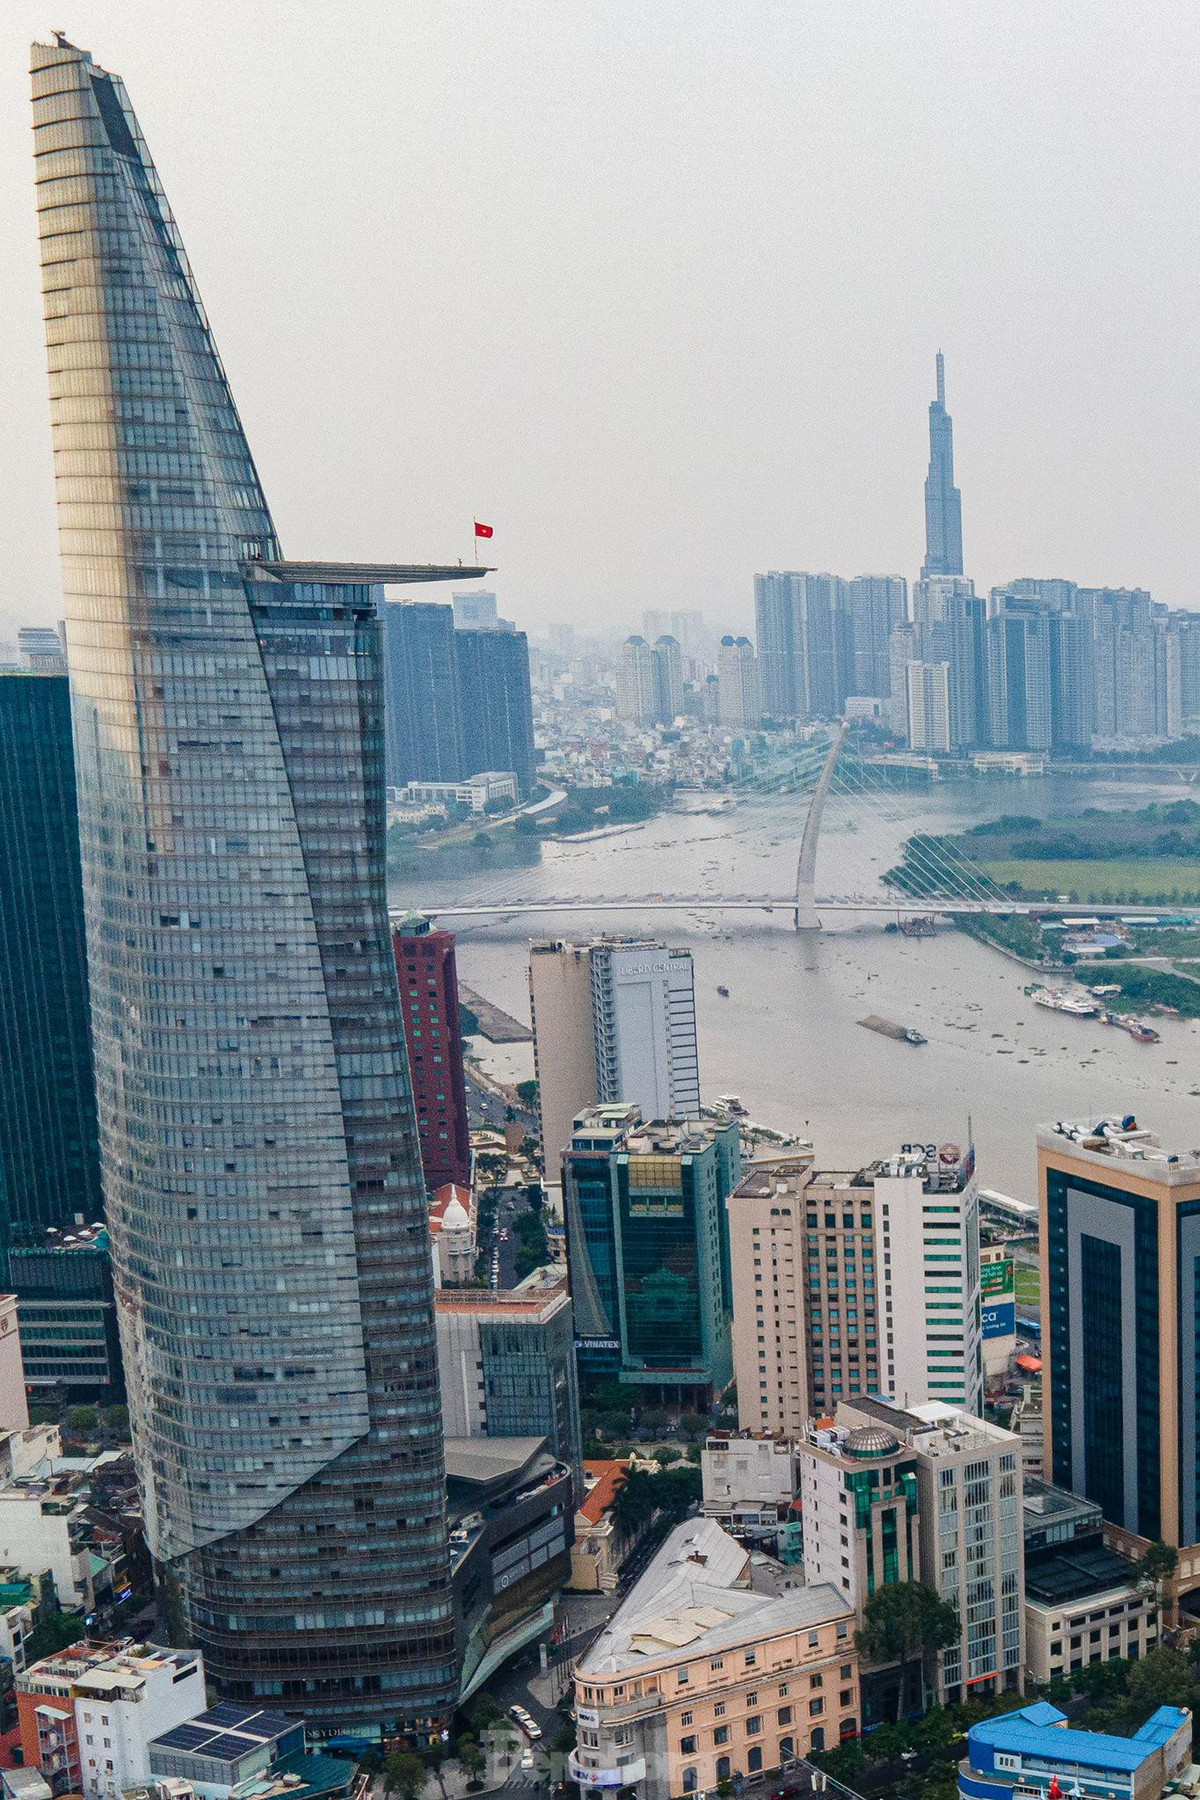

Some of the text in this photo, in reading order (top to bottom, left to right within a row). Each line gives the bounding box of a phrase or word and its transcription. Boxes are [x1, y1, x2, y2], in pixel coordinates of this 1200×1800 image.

[621, 962, 689, 976] LIBERTY CENTRAL
[584, 1340, 620, 1349] VINATEX
